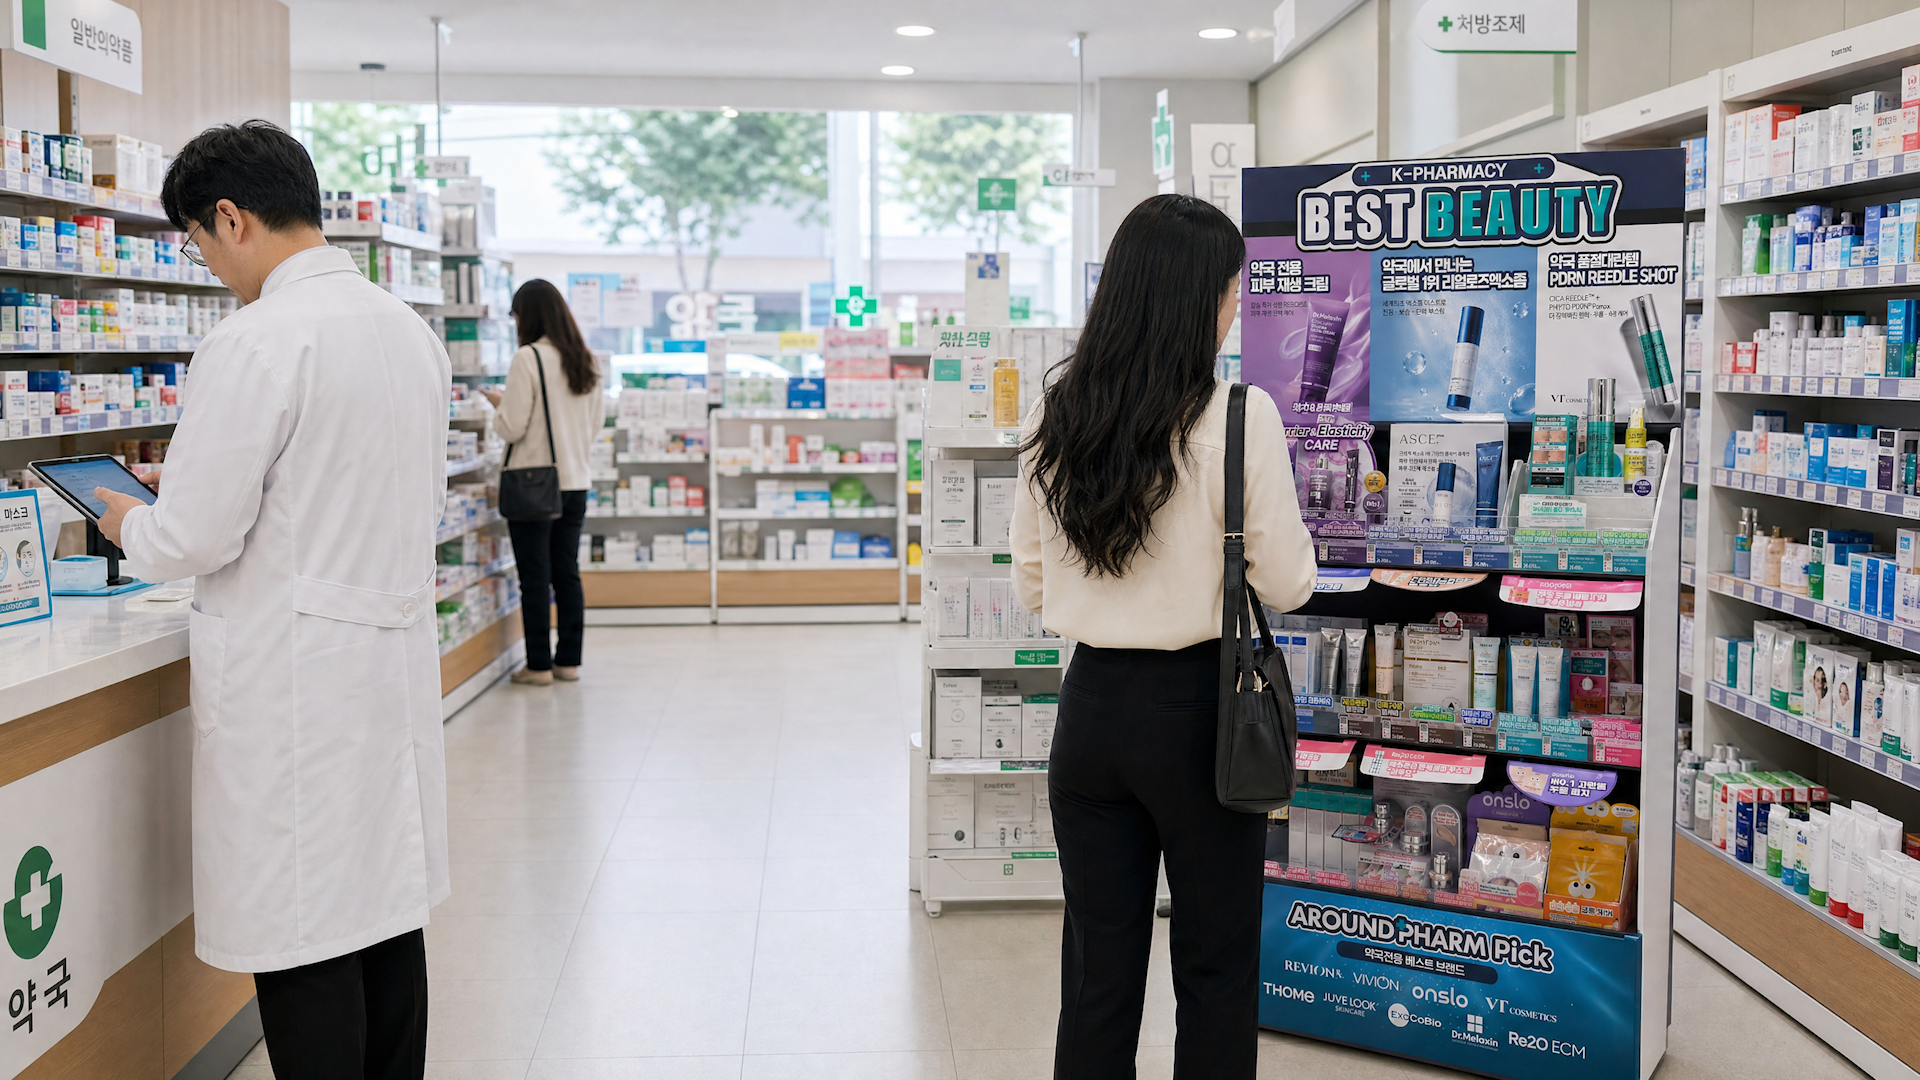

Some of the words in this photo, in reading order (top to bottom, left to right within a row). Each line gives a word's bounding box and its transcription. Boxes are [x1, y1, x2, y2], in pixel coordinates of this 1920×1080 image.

[1457, 14, 1525, 34] 처방조제
[71, 17, 133, 64] 일반의약품
[1392, 162, 1507, 182] K-PHARMACY
[1305, 193, 1410, 241] BEST
[1426, 185, 1613, 237] BEAUTY
[1250, 260, 1276, 276] 약국
[1277, 260, 1302, 276] 전용
[1382, 258, 1432, 274] 약국에서
[1549, 253, 1576, 269] 약국
[1577, 252, 1639, 268] 품절대란템
[1250, 277, 1276, 293] 피부
[1277, 276, 1302, 293] 재생
[1303, 276, 1329, 292] 크림
[1382, 275, 1420, 291] 글로벌
[1422, 274, 1440, 290] 1위
[1549, 270, 1586, 286] PDRN
[1588, 269, 1638, 285] REEDLE
[1640, 267, 1677, 283] SHOT
[1551, 394, 1566, 403] VT
[1317, 424, 1372, 440] Elasticity
[1304, 439, 1339, 451] CARE
[4, 507, 28, 520] 마스크
[1482, 793, 1531, 810] onslo
[1364, 947, 1403, 965] 약국전용
[1404, 955, 1434, 971] 베스트
[1435, 960, 1466, 976] 브랜드
[1494, 938, 1549, 969] Pick
[8, 957, 71, 1034] 약국
[1323, 992, 1348, 1006] JUVE
[1349, 997, 1377, 1011] LOOK
[1353, 971, 1400, 991] VIVION
[1412, 985, 1469, 1009] onslo
[1485, 996, 1509, 1014] VT
[1509, 1006, 1558, 1023] COSMETICS
[1335, 1005, 1366, 1018] SKINCARE
[1451, 1029, 1499, 1048] Dr.Meloxin
[1551, 1040, 1587, 1060] ECM
